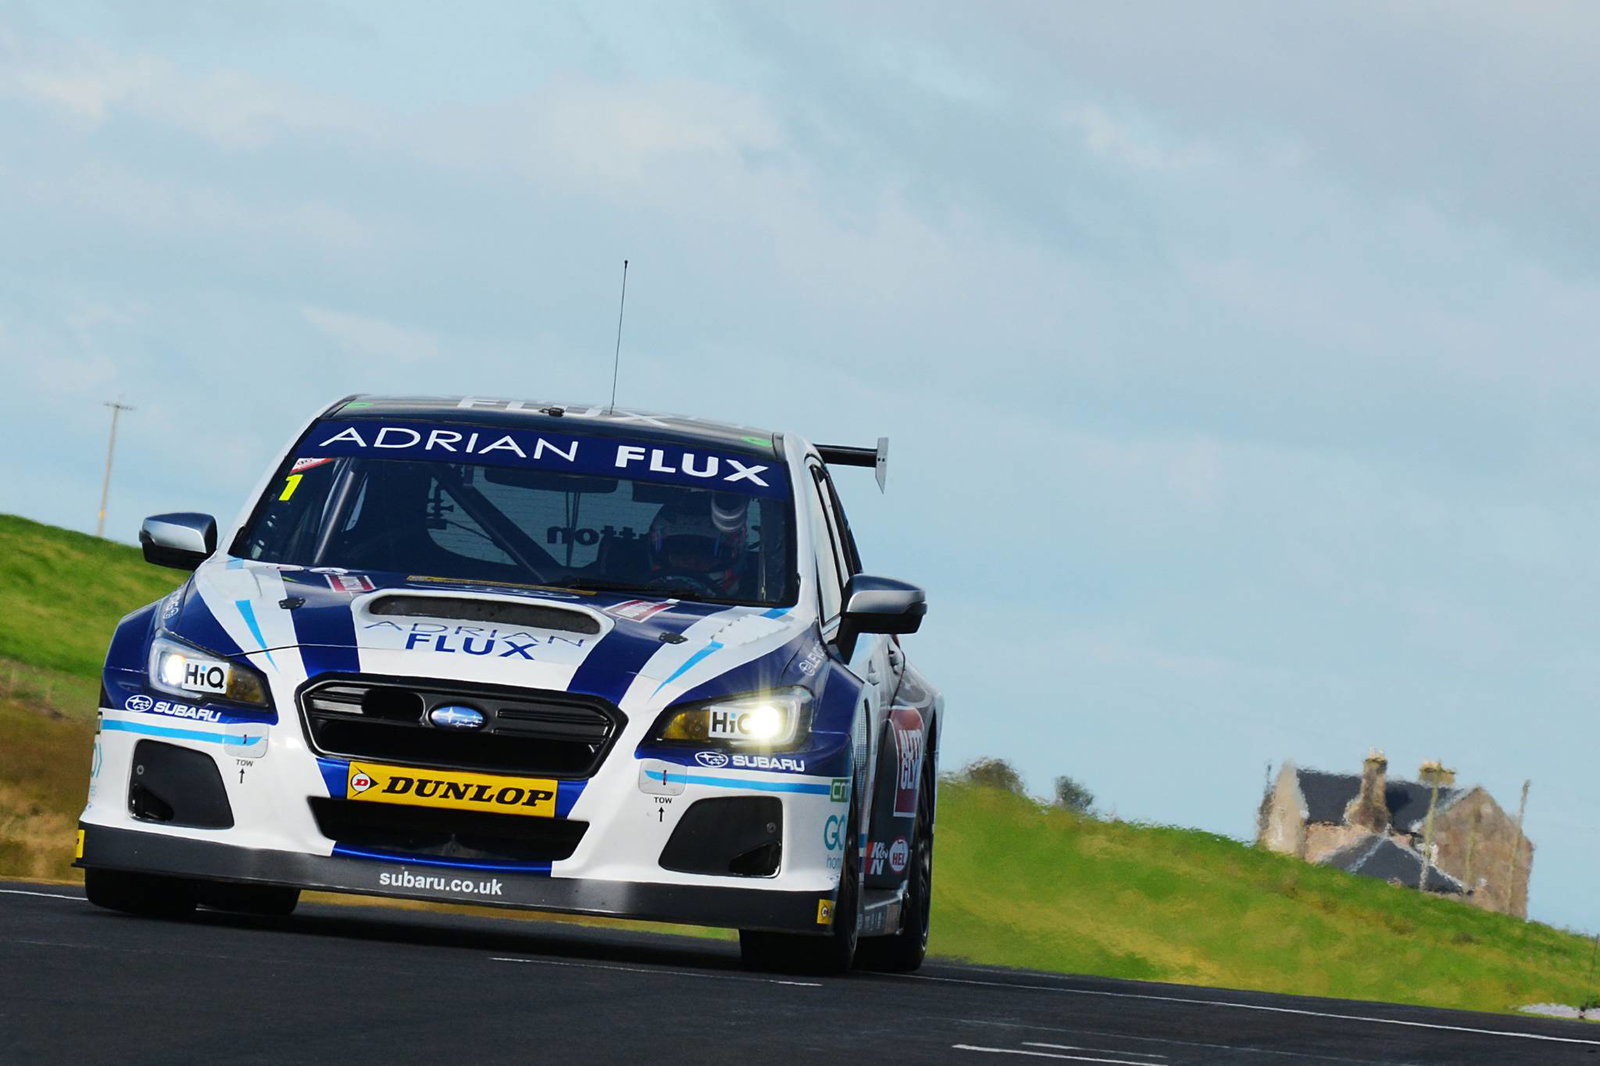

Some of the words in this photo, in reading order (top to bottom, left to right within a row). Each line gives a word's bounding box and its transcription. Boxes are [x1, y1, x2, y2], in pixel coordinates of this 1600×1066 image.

[319, 427, 579, 462] ADRIAN
[614, 445, 770, 487] FLUX
[279, 474, 303, 501] 1
[364, 620, 586, 647] ADRIAN
[405, 633, 538, 660] FLUX
[184, 663, 224, 689] HiQ
[153, 701, 222, 722] SUBARU
[236, 759, 254, 767] TOW
[732, 755, 805, 772] SUBARU
[381, 776, 554, 807] DUNLOP
[654, 796, 673, 804] TOW
[379, 871, 503, 895] subaru.co.uk
